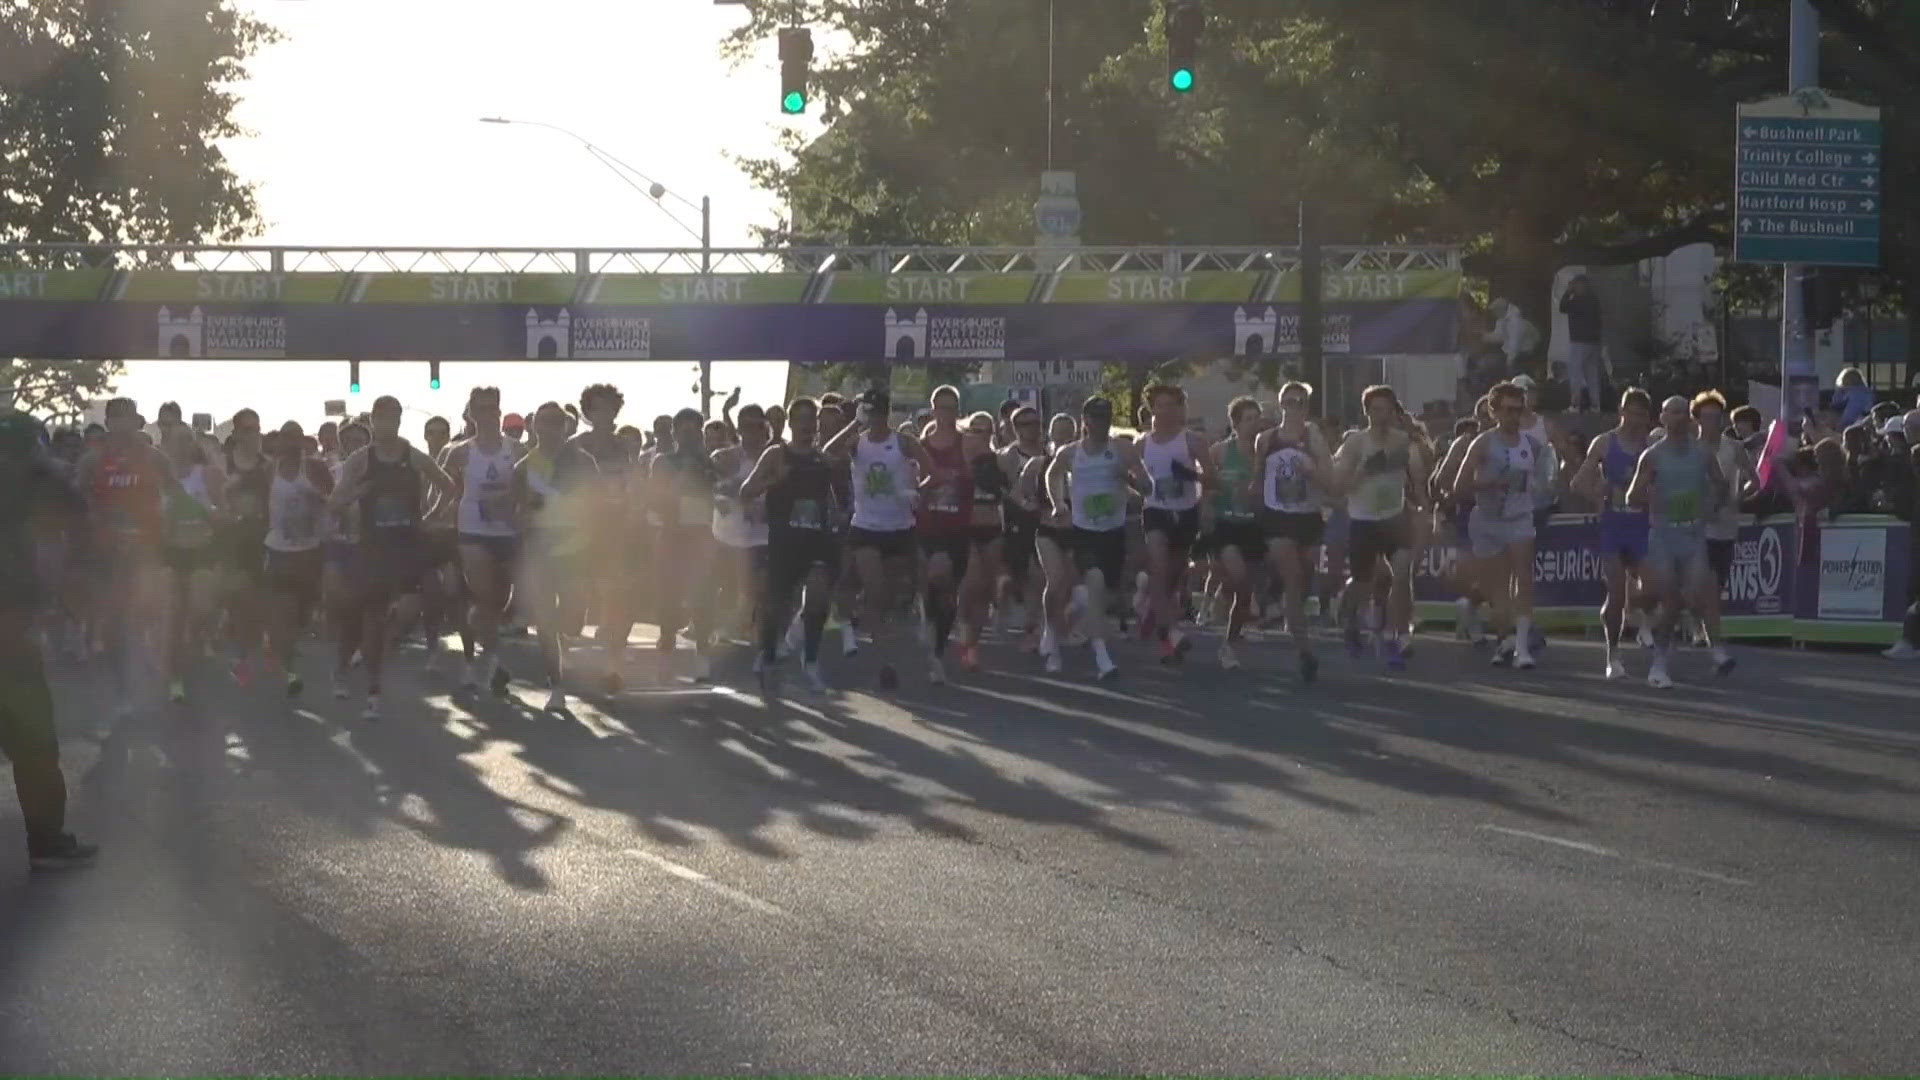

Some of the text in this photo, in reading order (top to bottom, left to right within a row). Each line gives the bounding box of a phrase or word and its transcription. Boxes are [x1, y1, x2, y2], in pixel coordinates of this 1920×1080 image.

[1760, 126, 1861, 141] Bushnell Park
[1742, 149, 1852, 166] Trinity College
[1741, 172, 1844, 186] Child Med Ctr
[1740, 195, 1847, 213] Hartford Hosp
[1759, 218, 1855, 234] The Bushnell
[197, 274, 285, 299] START
[429, 276, 517, 300] START
[658, 276, 747, 300] START
[886, 276, 971, 300] START
[1108, 275, 1191, 300] START
[1326, 274, 1407, 298] START
[573, 318, 649, 328] EVERSOURCE
[931, 317, 1004, 327] EVERSOURCE
[207, 338, 285, 349] MARATHON
[573, 339, 649, 350] MARATHON
[931, 338, 1004, 349] MARATHON
[1016, 370, 1046, 384] ONLY
[1068, 370, 1098, 383] ONLY
